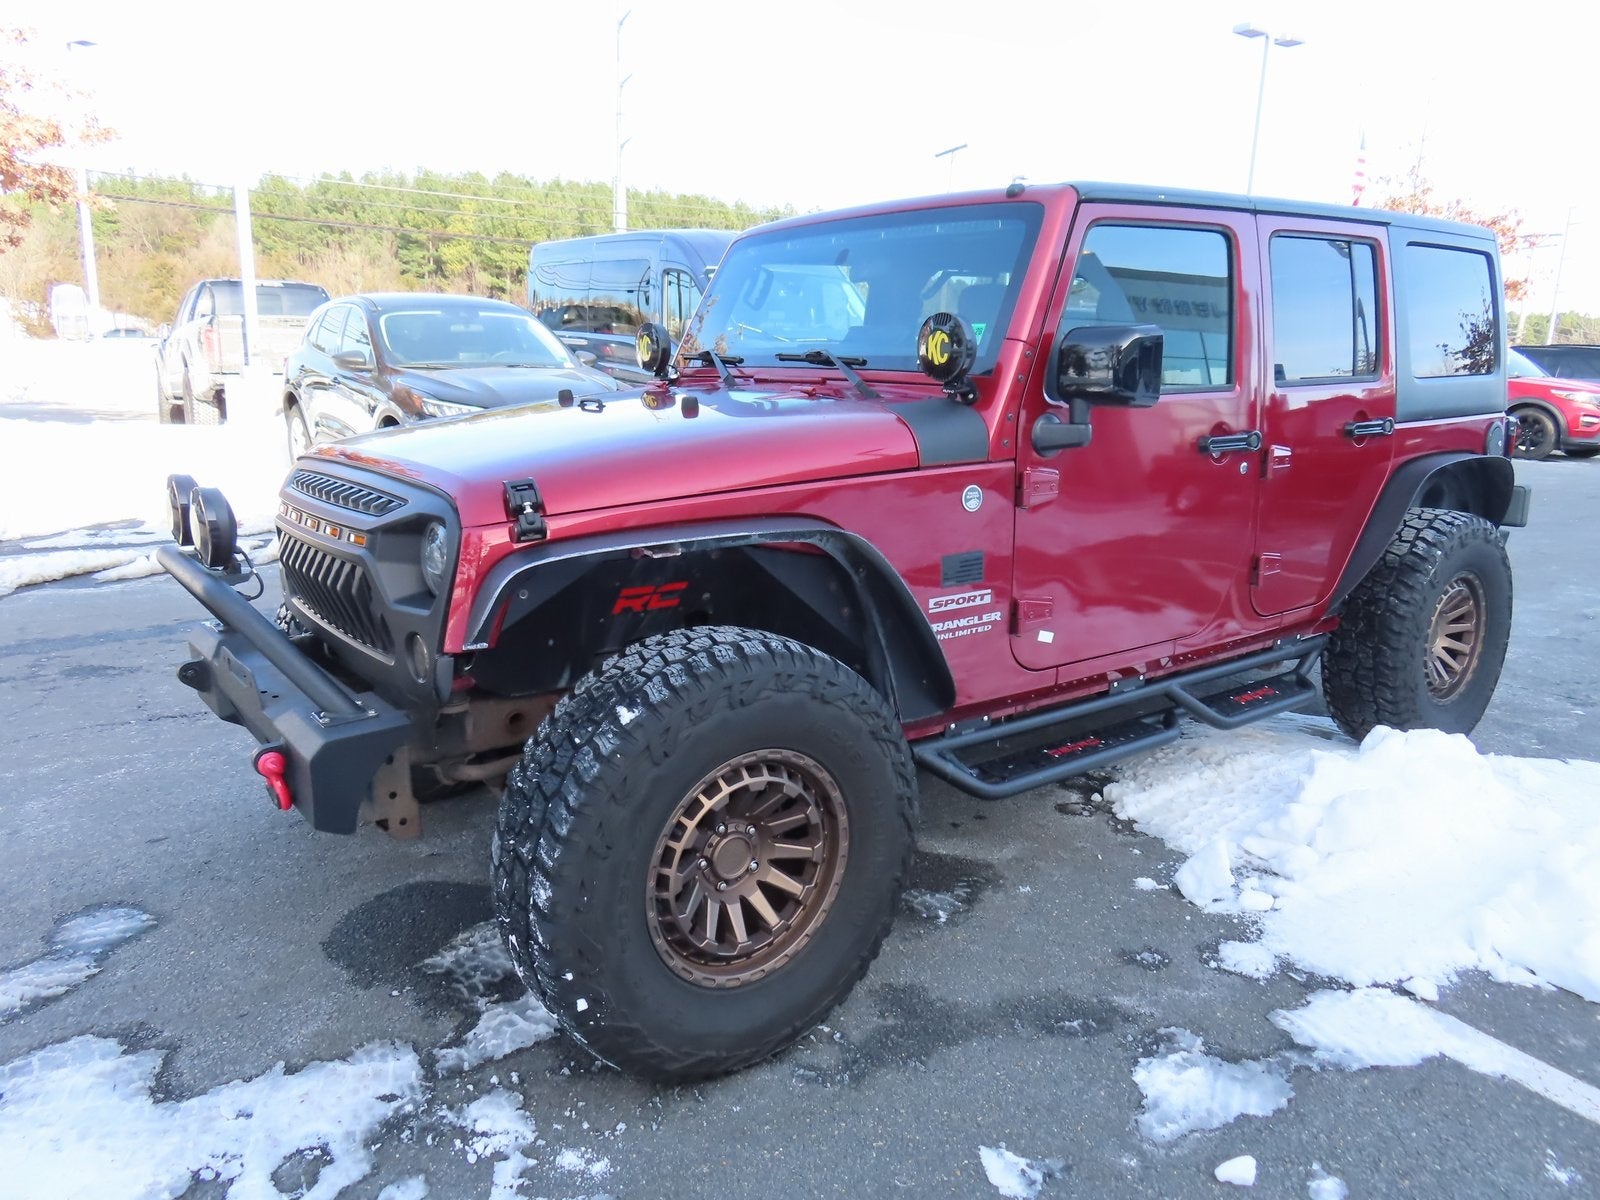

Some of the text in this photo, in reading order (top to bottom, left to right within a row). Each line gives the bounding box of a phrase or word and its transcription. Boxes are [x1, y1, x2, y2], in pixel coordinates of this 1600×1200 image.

[640, 334, 652, 363] KC
[927, 330, 949, 366] KC
[611, 581, 689, 616] RC
[931, 592, 988, 609] SPORT
[930, 611, 1002, 633] RANGLER
